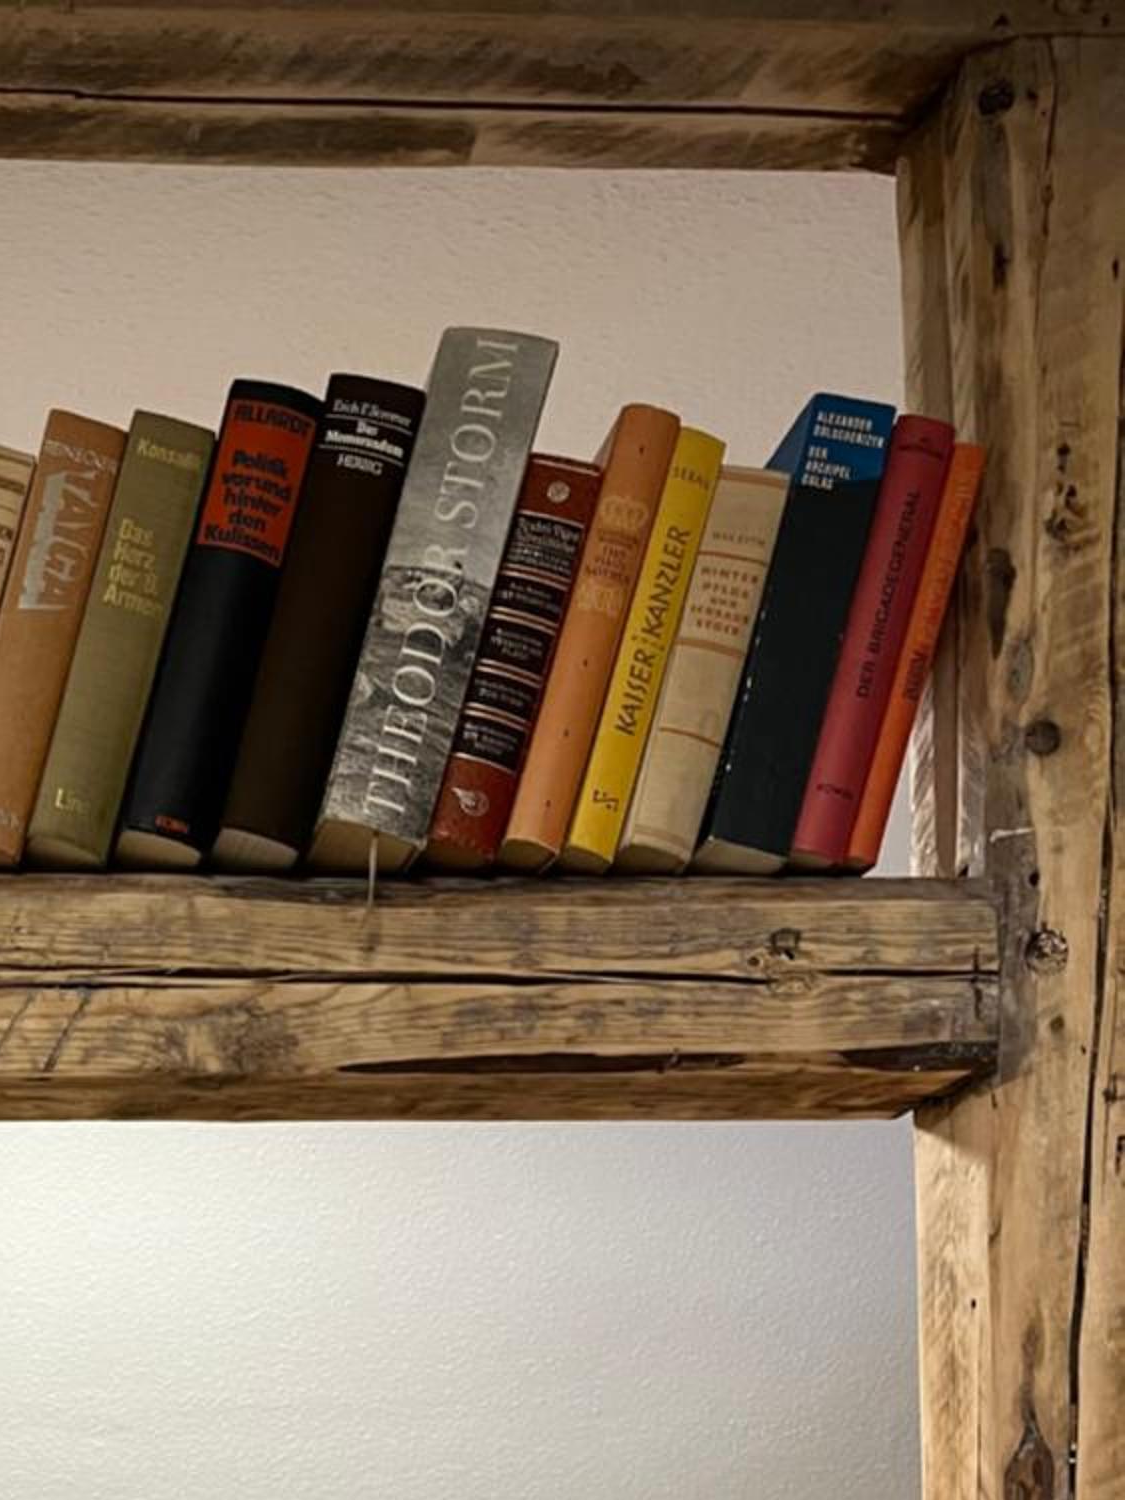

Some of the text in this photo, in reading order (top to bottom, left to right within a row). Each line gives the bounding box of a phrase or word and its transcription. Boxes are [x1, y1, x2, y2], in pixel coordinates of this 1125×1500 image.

[808, 445, 828, 460] DER
[365, 543, 467, 816] THEODOR
[435, 338, 519, 528] STORM
[612, 647, 658, 736] KAISER
[639, 523, 692, 640] KANZLER
